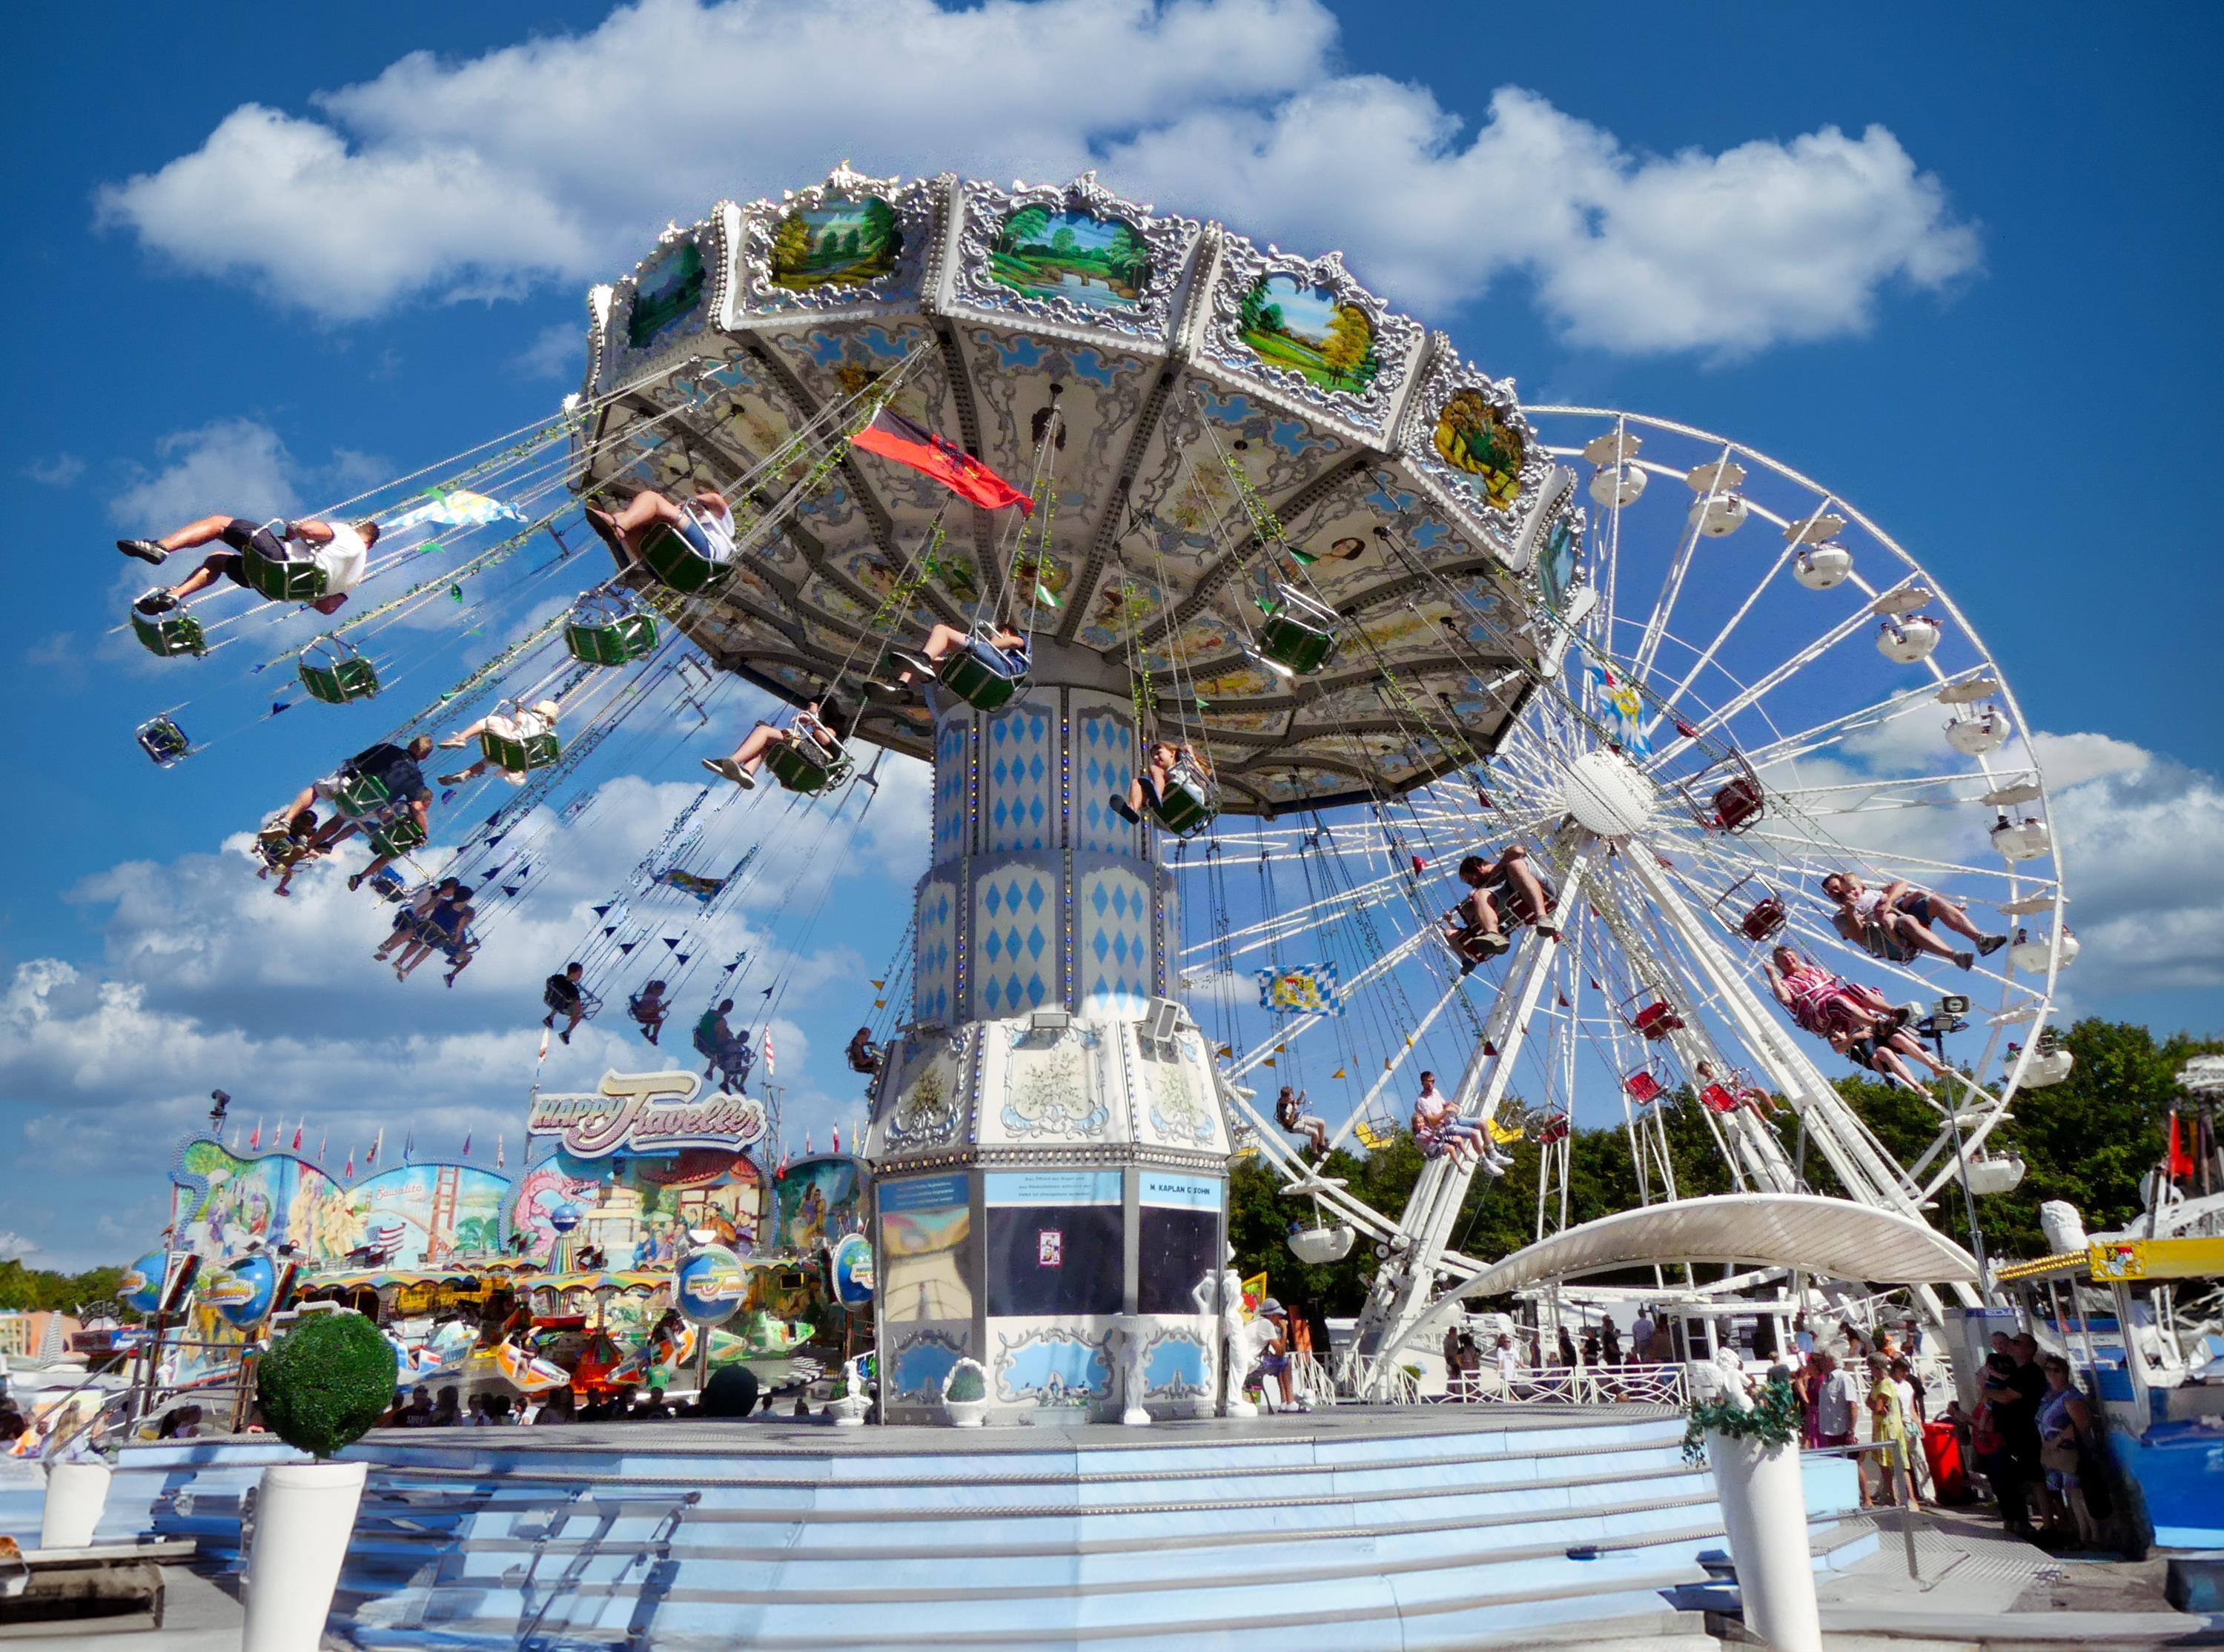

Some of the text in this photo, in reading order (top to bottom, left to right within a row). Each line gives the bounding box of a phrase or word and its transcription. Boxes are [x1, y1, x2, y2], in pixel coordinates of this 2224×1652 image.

[532, 1075, 761, 1152] HAPPY Traveller
[1159, 1184, 1185, 1193] KAPLAN
